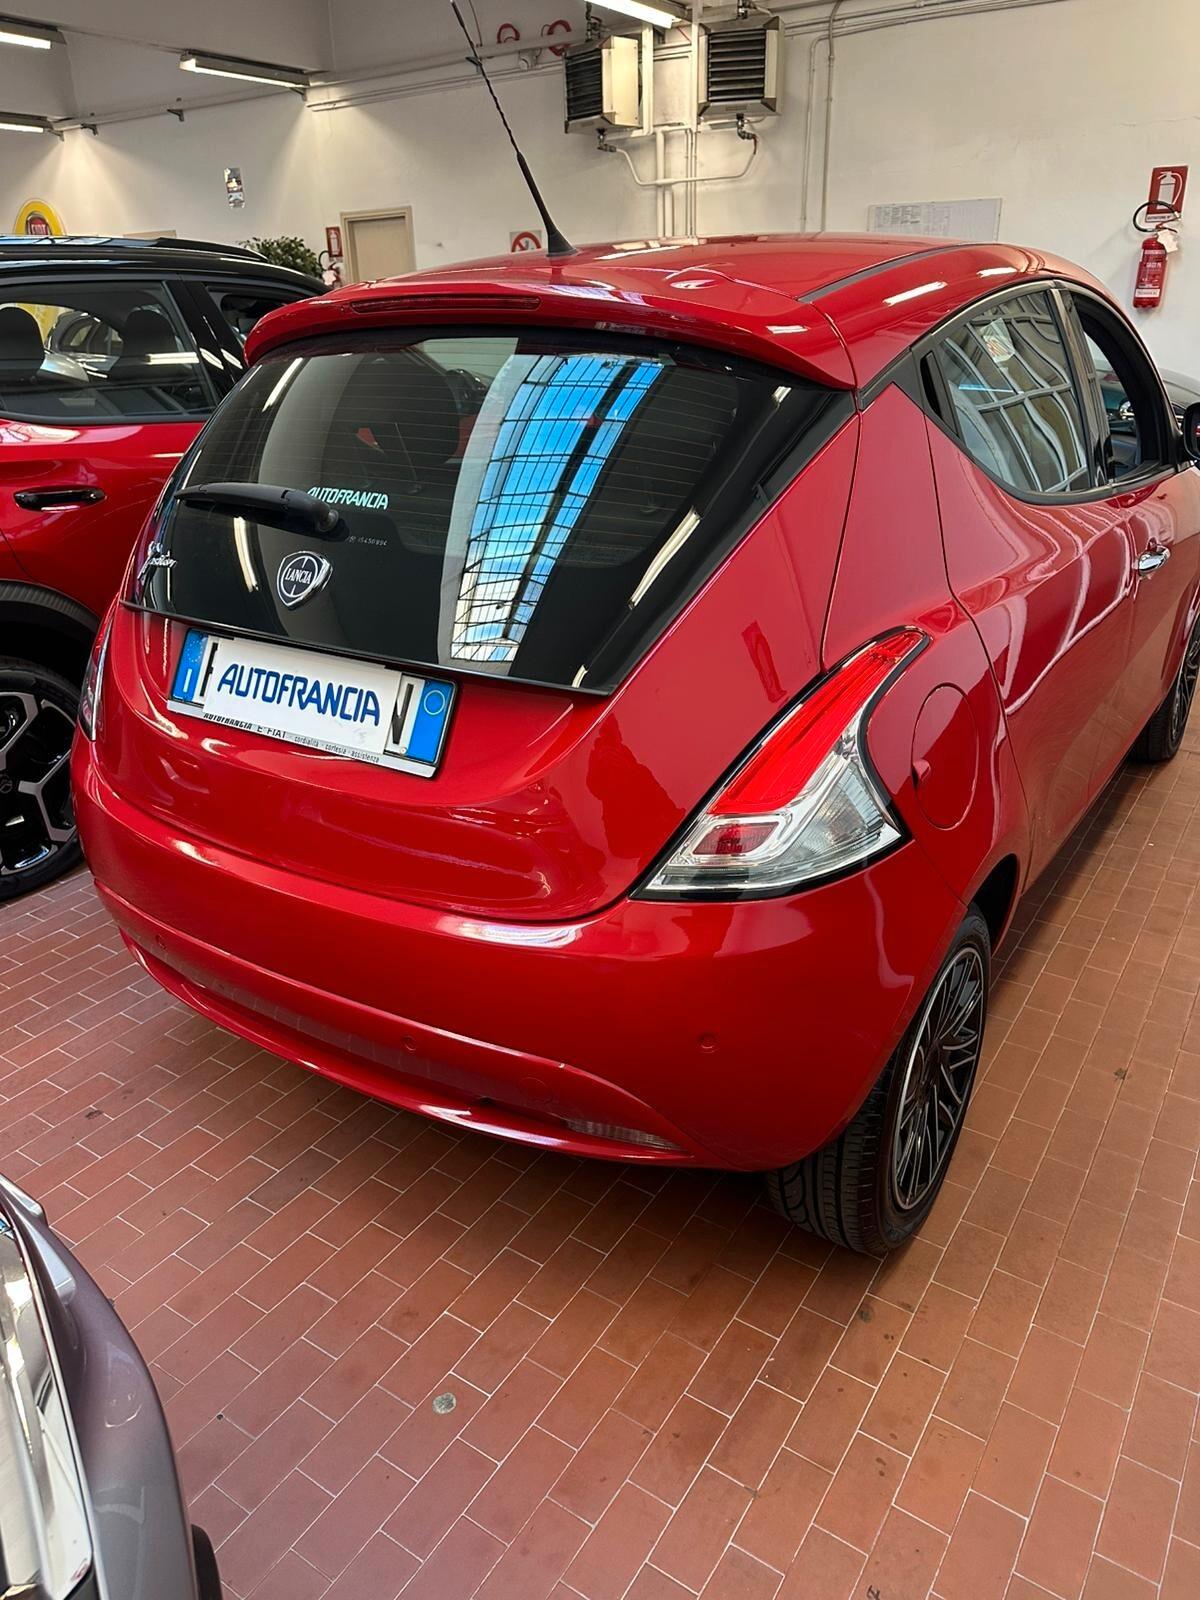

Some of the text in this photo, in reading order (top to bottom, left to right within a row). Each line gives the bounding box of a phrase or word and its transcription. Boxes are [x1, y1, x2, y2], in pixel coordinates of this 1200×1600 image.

[307, 486, 389, 510] AUTOFRANCIA
[284, 567, 313, 585] LANCIA
[217, 663, 380, 727] AUTOFRANCIA
